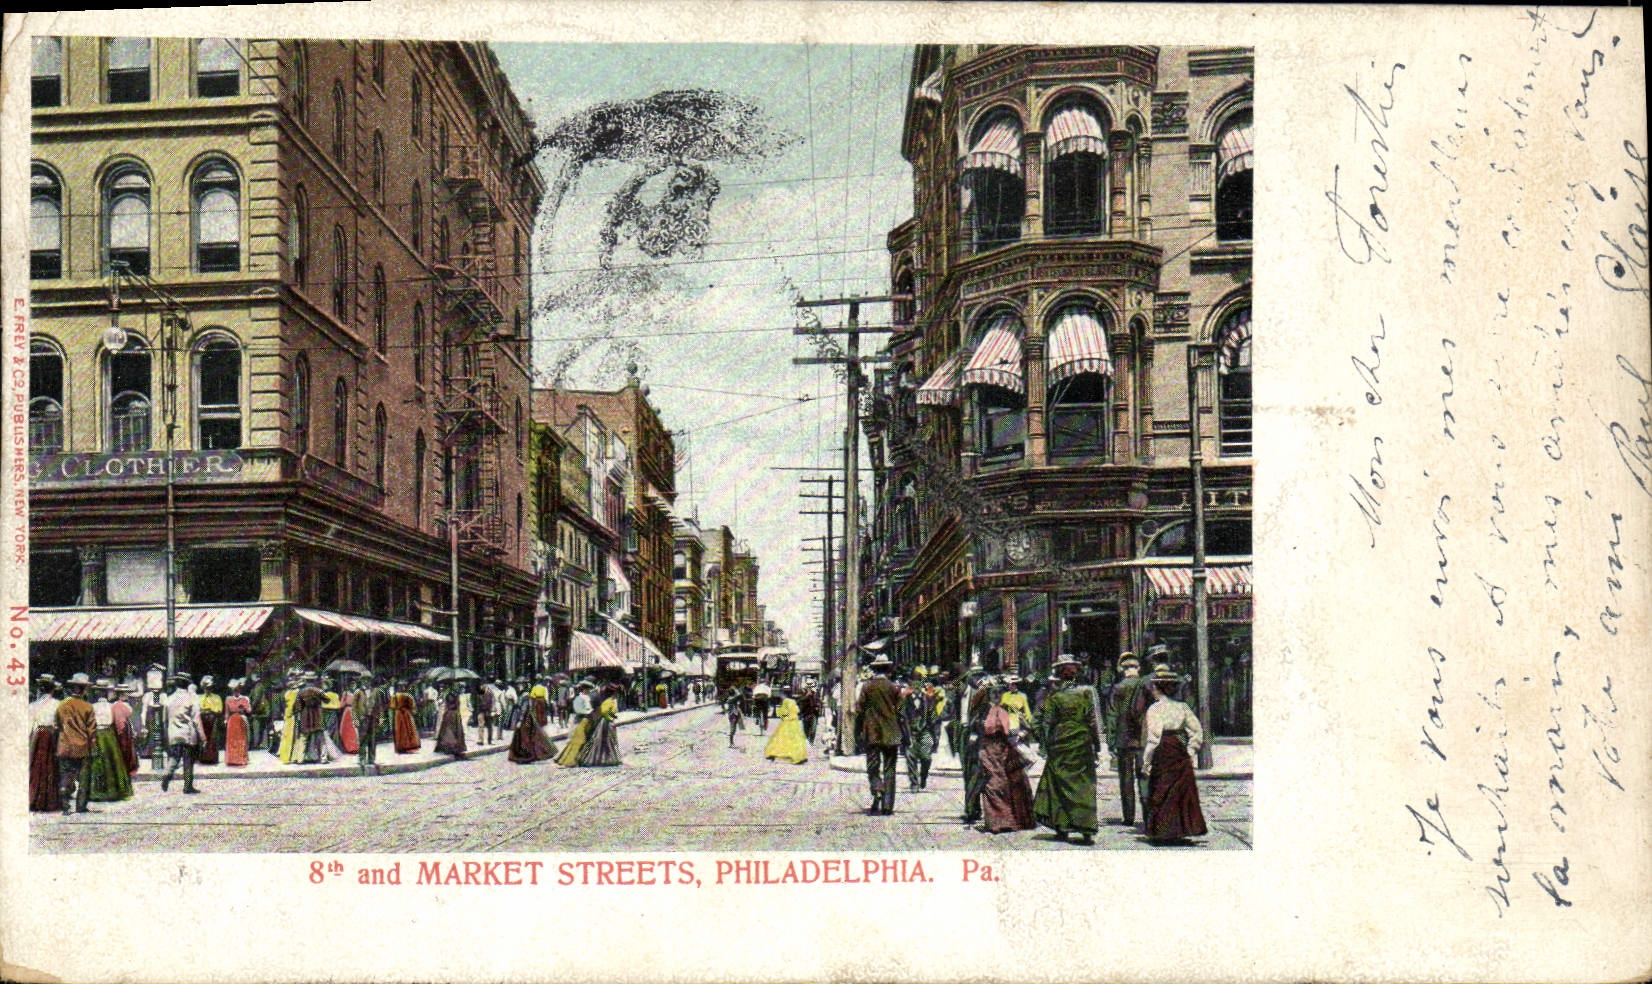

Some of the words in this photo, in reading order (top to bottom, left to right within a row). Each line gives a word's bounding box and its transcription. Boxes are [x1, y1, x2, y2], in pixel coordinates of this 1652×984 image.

[12, 356, 25, 366] &
[13, 315, 25, 349] FREY
[1351, 314, 1385, 405] cher
[1441, 337, 1455, 440] mes
[61, 455, 233, 478] CLOTHIER
[1348, 437, 1385, 548] Mon
[1488, 433, 1509, 543] vous
[14, 489, 25, 517] NEW
[1543, 495, 1563, 590] mes
[1585, 491, 1623, 636] ami
[9, 606, 29, 649] No.
[1420, 648, 1447, 761] vous
[1405, 794, 1473, 860] Je
[308, 859, 344, 884] 8th
[358, 861, 401, 885] and
[417, 860, 543, 885] MARKET
[557, 860, 701, 887] STREETS,
[715, 859, 934, 884] PHILADELPHIA.
[962, 858, 1000, 883] Pa.
[1532, 856, 1572, 908] la
